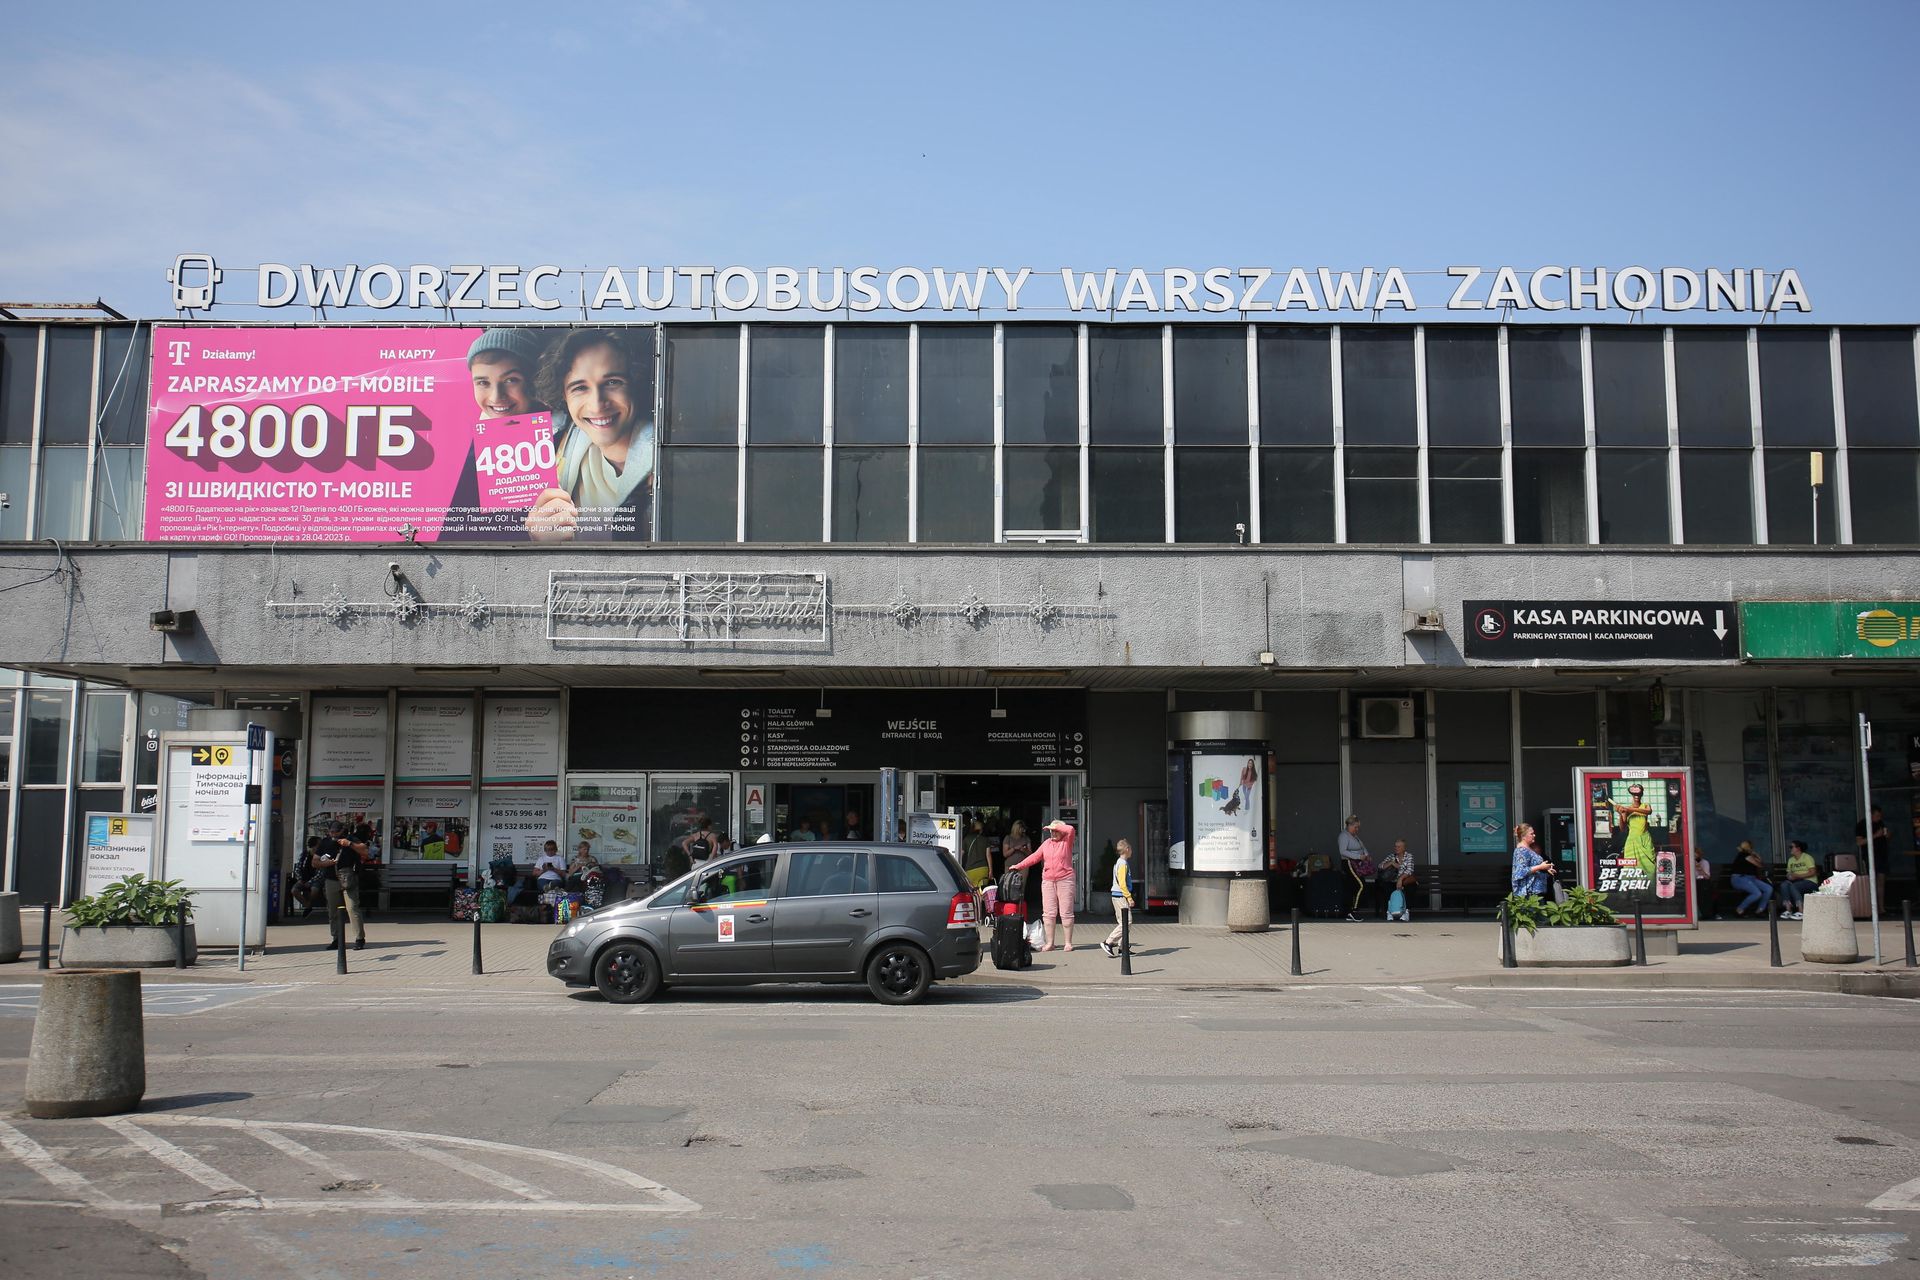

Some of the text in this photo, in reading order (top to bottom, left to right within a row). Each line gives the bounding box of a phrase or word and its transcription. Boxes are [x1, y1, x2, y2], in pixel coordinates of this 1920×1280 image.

[258, 264, 1812, 313] DWORZEC AUTOBUSOWY WARSZAWA ZACHODNIA
[202, 350, 256, 361] Działamy!
[380, 350, 436, 359] НА КАРТУ
[168, 376, 434, 393] ZAPRASZAMY DO T-MOBILE
[164, 404, 416, 458] 4800 ГБ
[534, 428, 551, 442] ГБ
[476, 440, 556, 476] 4800
[496, 474, 540, 486] ДОДАТКОВО
[165, 482, 412, 500] ЗІ ШВИДКІСТЮ T-MOBILE
[489, 482, 549, 496] ПРОТЯГОМ РОКУ
[1513, 609, 1704, 625] KASA PARKINGOWA
[887, 718, 937, 730] WEJŚCIE
[249, 727, 265, 748] TAXI
[196, 773, 247, 781] Інформація
[610, 787, 637, 796] Kebab
[747, 789, 762, 805] A
[613, 814, 625, 823] 60
[1599, 868, 1618, 880] BE
[1599, 880, 1651, 892] BE REAL!
